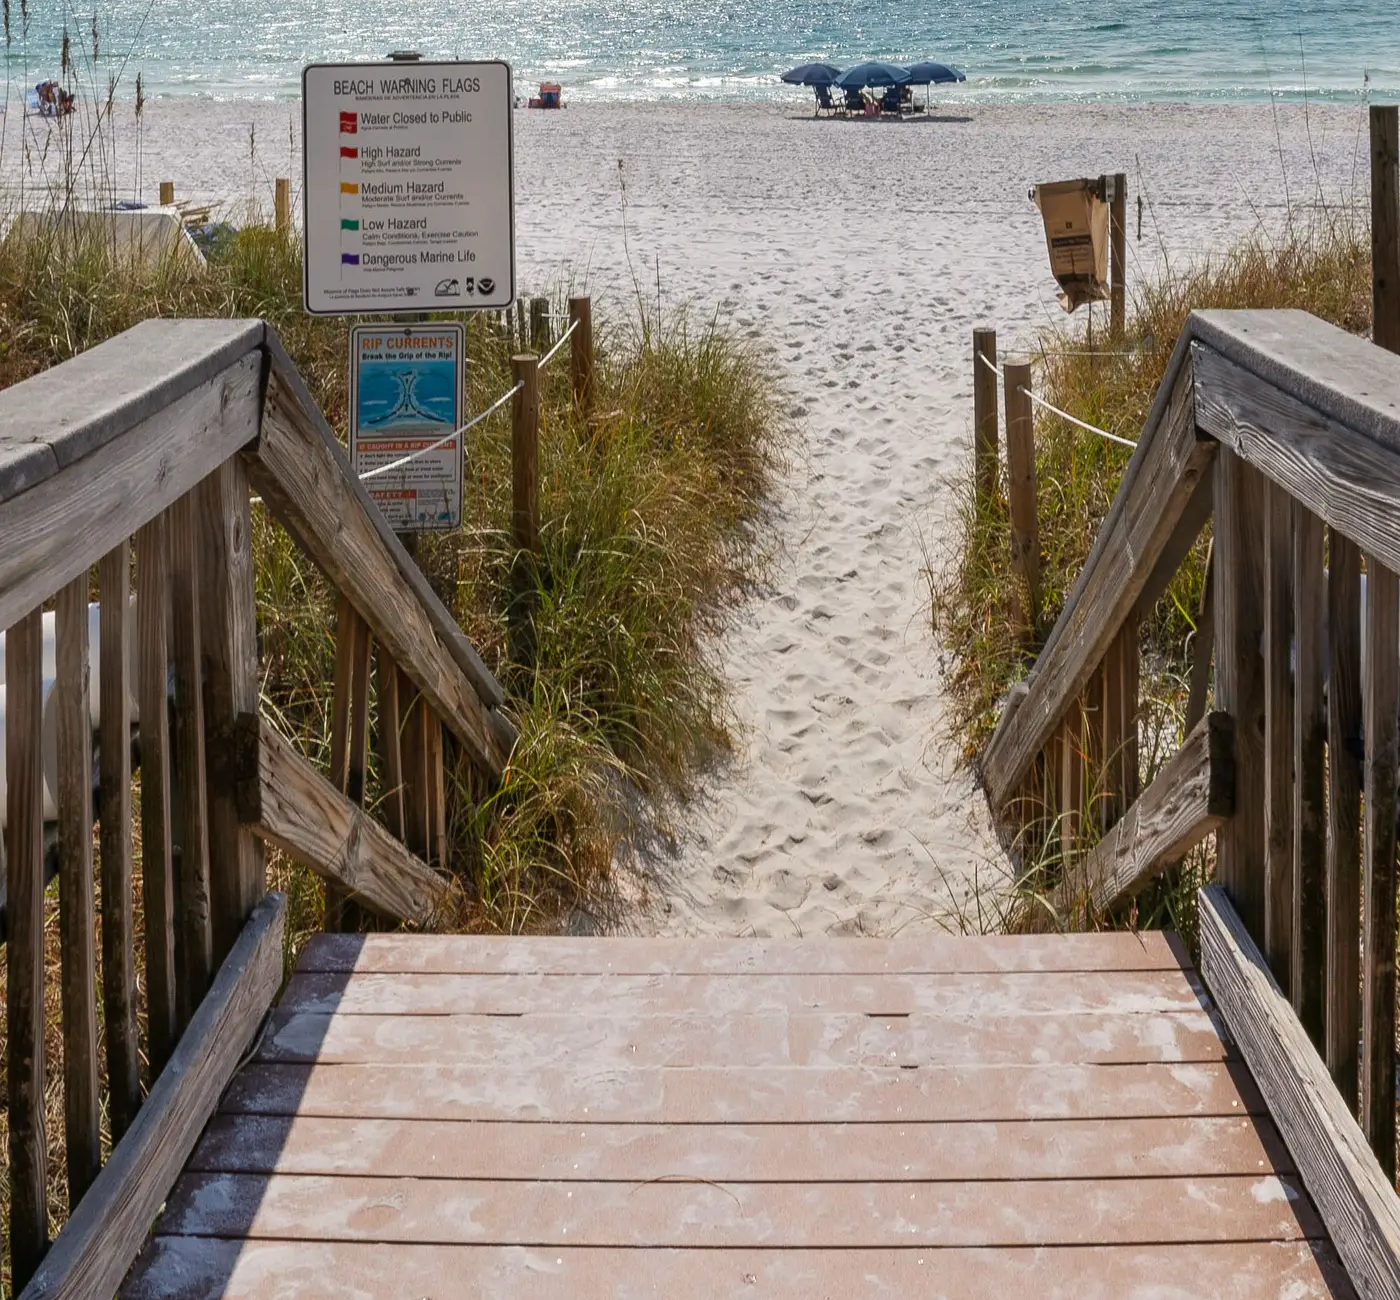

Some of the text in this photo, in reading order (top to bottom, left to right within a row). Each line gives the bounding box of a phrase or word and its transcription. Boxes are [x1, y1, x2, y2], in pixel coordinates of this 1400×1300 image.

[333, 77, 481, 95] BEACH WARNING FLAGS
[361, 110, 473, 125] Water Closed to Public
[361, 145, 421, 161] High Hazard
[362, 160, 375, 168] High
[413, 159, 434, 167] Strong
[434, 158, 462, 166] Currents
[361, 180, 445, 195] Medium Hazard
[362, 195, 394, 203] Moderate
[395, 194, 410, 202] Surf
[434, 192, 464, 200] Currents
[362, 217, 427, 231] Low Hazard
[362, 233, 381, 241] Calm
[452, 229, 479, 238] Caution
[362, 249, 476, 267] Dangerous Marine Life
[362, 336, 454, 349] RIP CURRENTS
[362, 353, 383, 361] Break
[386, 352, 397, 360] the
[399, 352, 414, 361] Grip
[425, 351, 437, 359] the
[439, 351, 453, 360] Rip!
